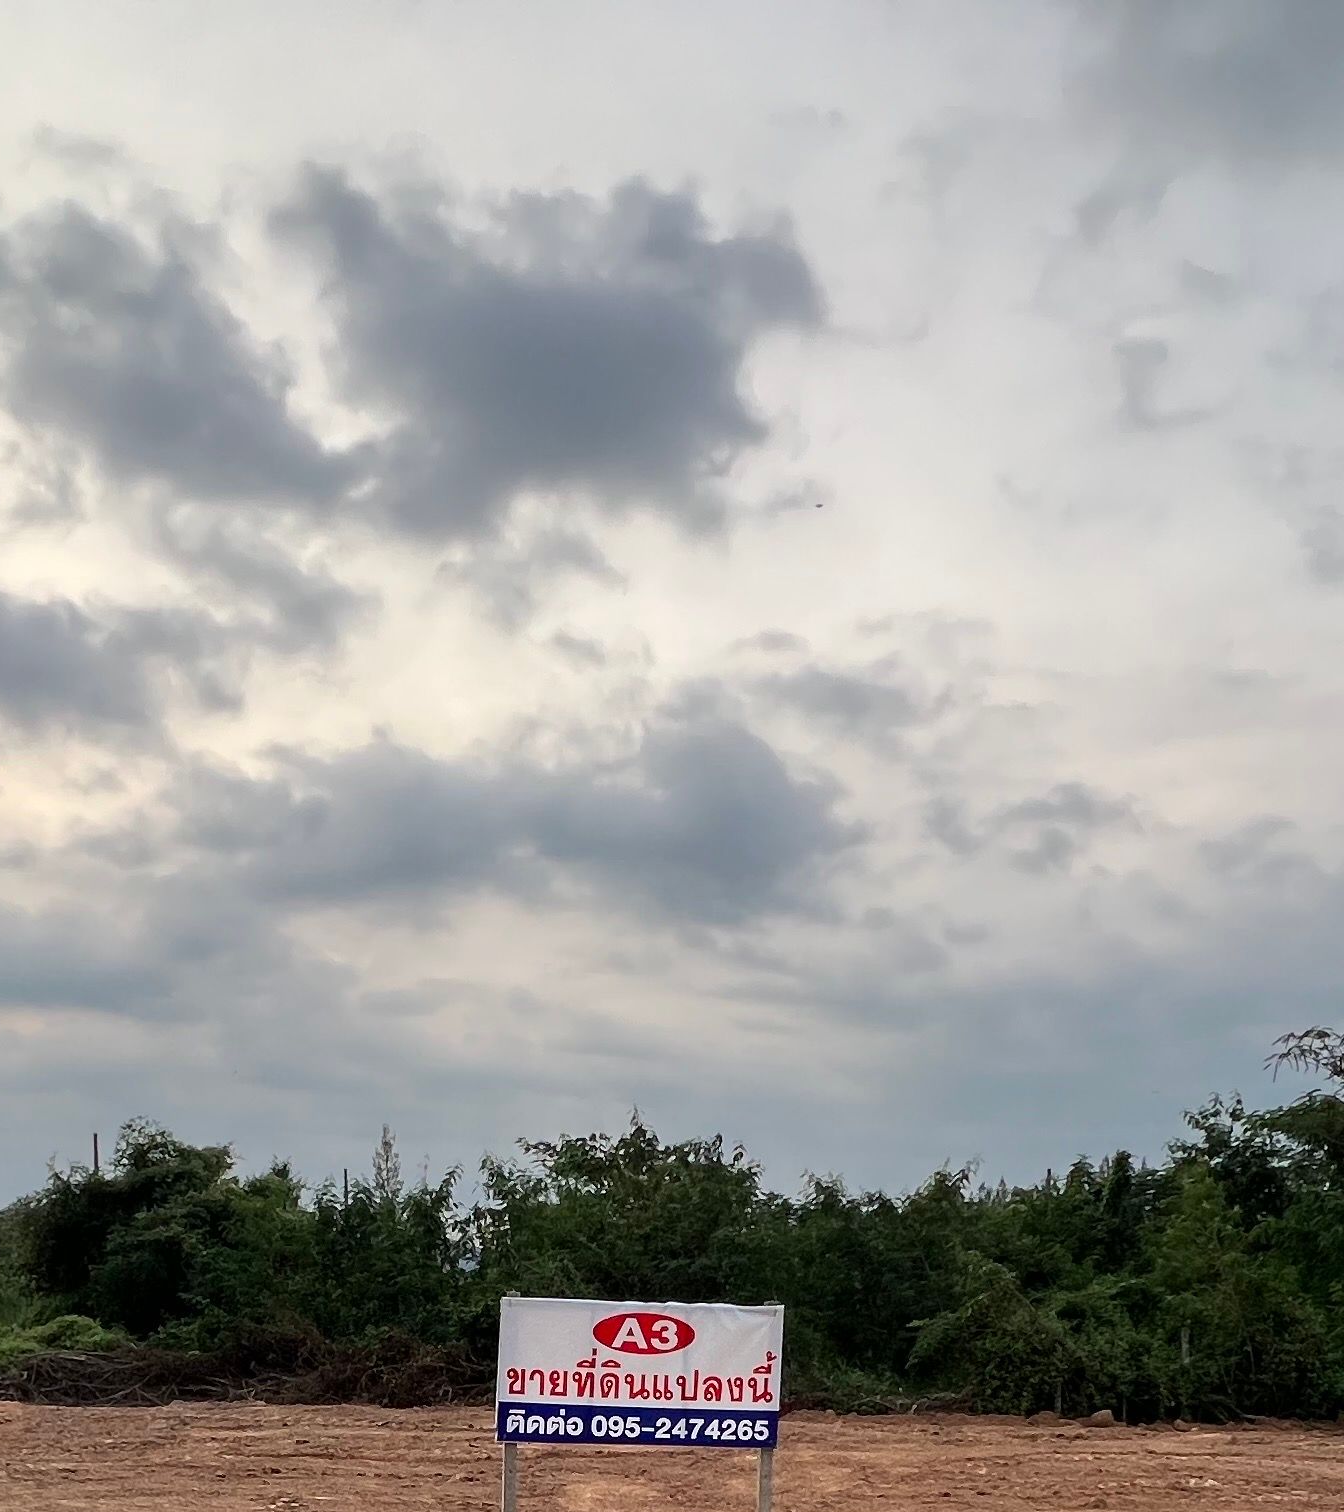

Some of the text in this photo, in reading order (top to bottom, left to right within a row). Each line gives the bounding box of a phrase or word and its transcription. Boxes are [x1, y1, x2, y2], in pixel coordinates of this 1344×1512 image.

[611, 1317, 678, 1351] A3
[506, 1348, 777, 1404] ขายที่ดินแปลงนี้
[506, 1408, 770, 1441] ติดต่อ 095-2474265
